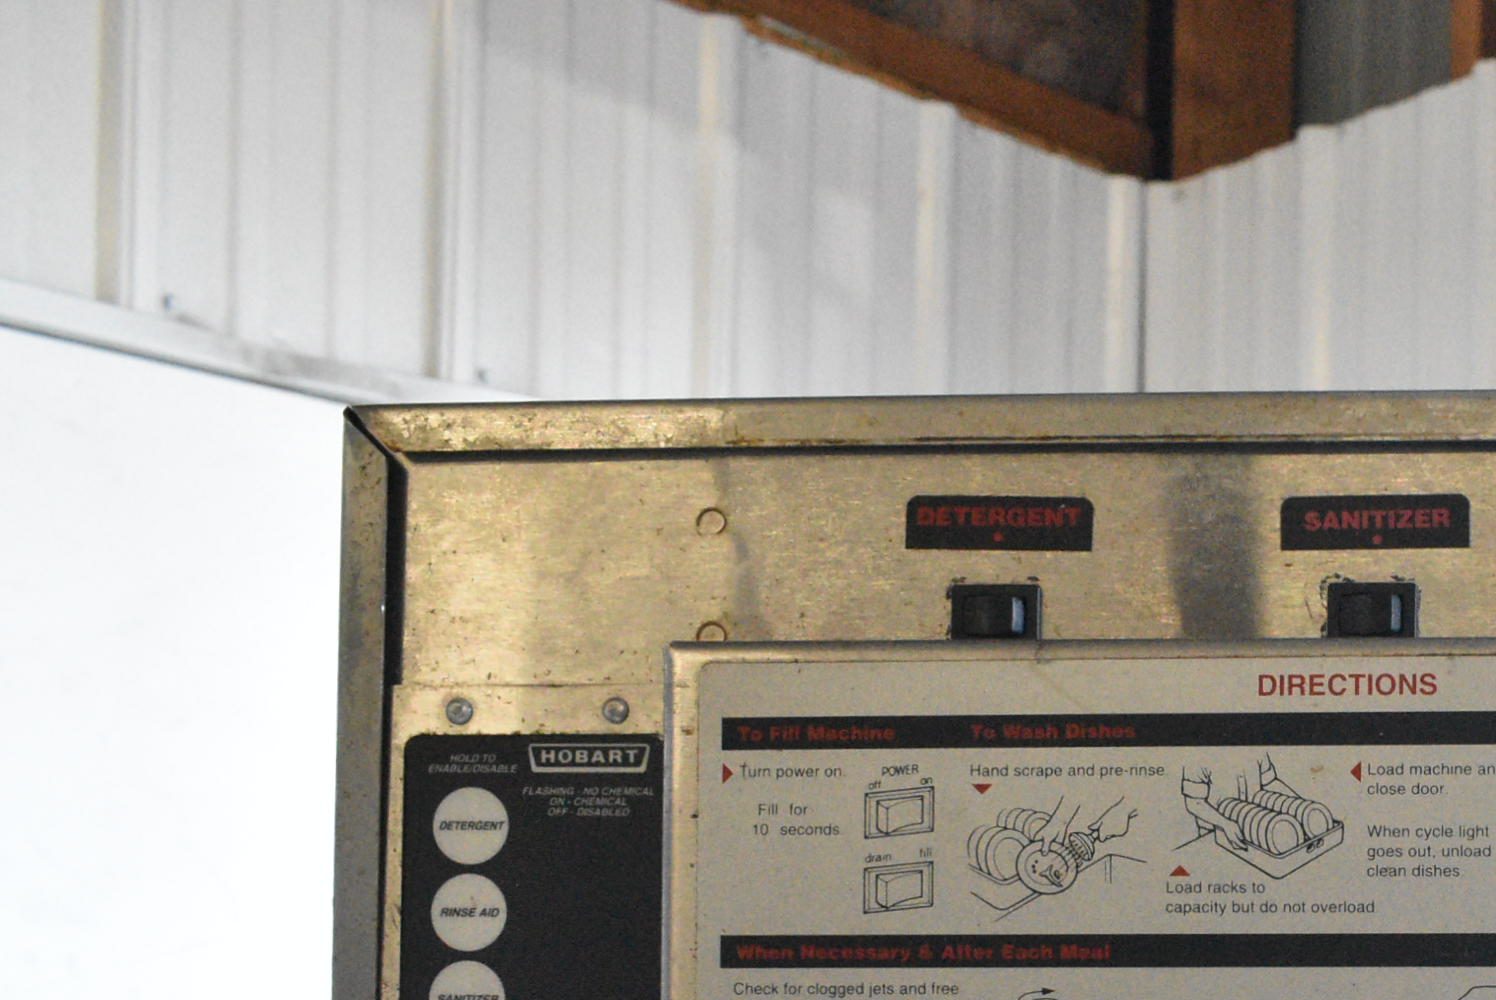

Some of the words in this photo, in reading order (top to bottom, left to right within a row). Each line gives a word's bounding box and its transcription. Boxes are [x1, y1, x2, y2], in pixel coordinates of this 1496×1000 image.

[917, 506, 1081, 526] DETERGENT
[1305, 508, 1451, 531] SANITIZER
[1258, 673, 1437, 696] DIRECTIONS
[738, 726, 764, 741] To
[770, 726, 801, 740] Fill
[807, 726, 895, 741] Machine
[971, 724, 997, 739] To
[1004, 725, 1060, 739] Wash
[1066, 723, 1136, 739] Dishes
[541, 750, 638, 763] HOBART
[740, 762, 771, 780] Turn
[776, 768, 819, 780] power
[970, 764, 1009, 777] Hand
[1014, 767, 1062, 779] scrape
[1068, 764, 1095, 776] and
[1368, 763, 1404, 776] Load
[1409, 763, 1472, 775] machine
[1367, 783, 1406, 795] close
[758, 803, 778, 816] Fill
[789, 803, 808, 816] for
[439, 820, 505, 831] DETERGENT
[753, 823, 769, 836] 10
[780, 824, 840, 836] seconds
[1367, 825, 1410, 838] When
[1415, 825, 1453, 841] cycle
[1459, 825, 1489, 841] light
[1367, 847, 1403, 861] goes
[1408, 846, 1435, 858] out,
[1441, 845, 1491, 857] unload
[1367, 865, 1406, 877] clean
[1166, 881, 1202, 894] Load
[1208, 881, 1247, 894] racks
[1252, 882, 1265, 894] to
[440, 907, 476, 917] RINSE
[479, 908, 500, 917] AID
[1165, 901, 1227, 916] capacity
[1232, 901, 1254, 913] but
[1259, 901, 1278, 913] do
[1283, 902, 1306, 913] not
[737, 945, 794, 960] When
[801, 944, 912, 961] Necessary
[942, 945, 994, 960] After
[1001, 944, 1054, 960] Each
[1060, 944, 1111, 960] Meal
[733, 982, 779, 995] Check
[784, 982, 803, 995] for
[807, 983, 864, 999] clogged
[869, 984, 894, 998] jets
[899, 983, 926, 995] and
[931, 982, 959, 995] free
